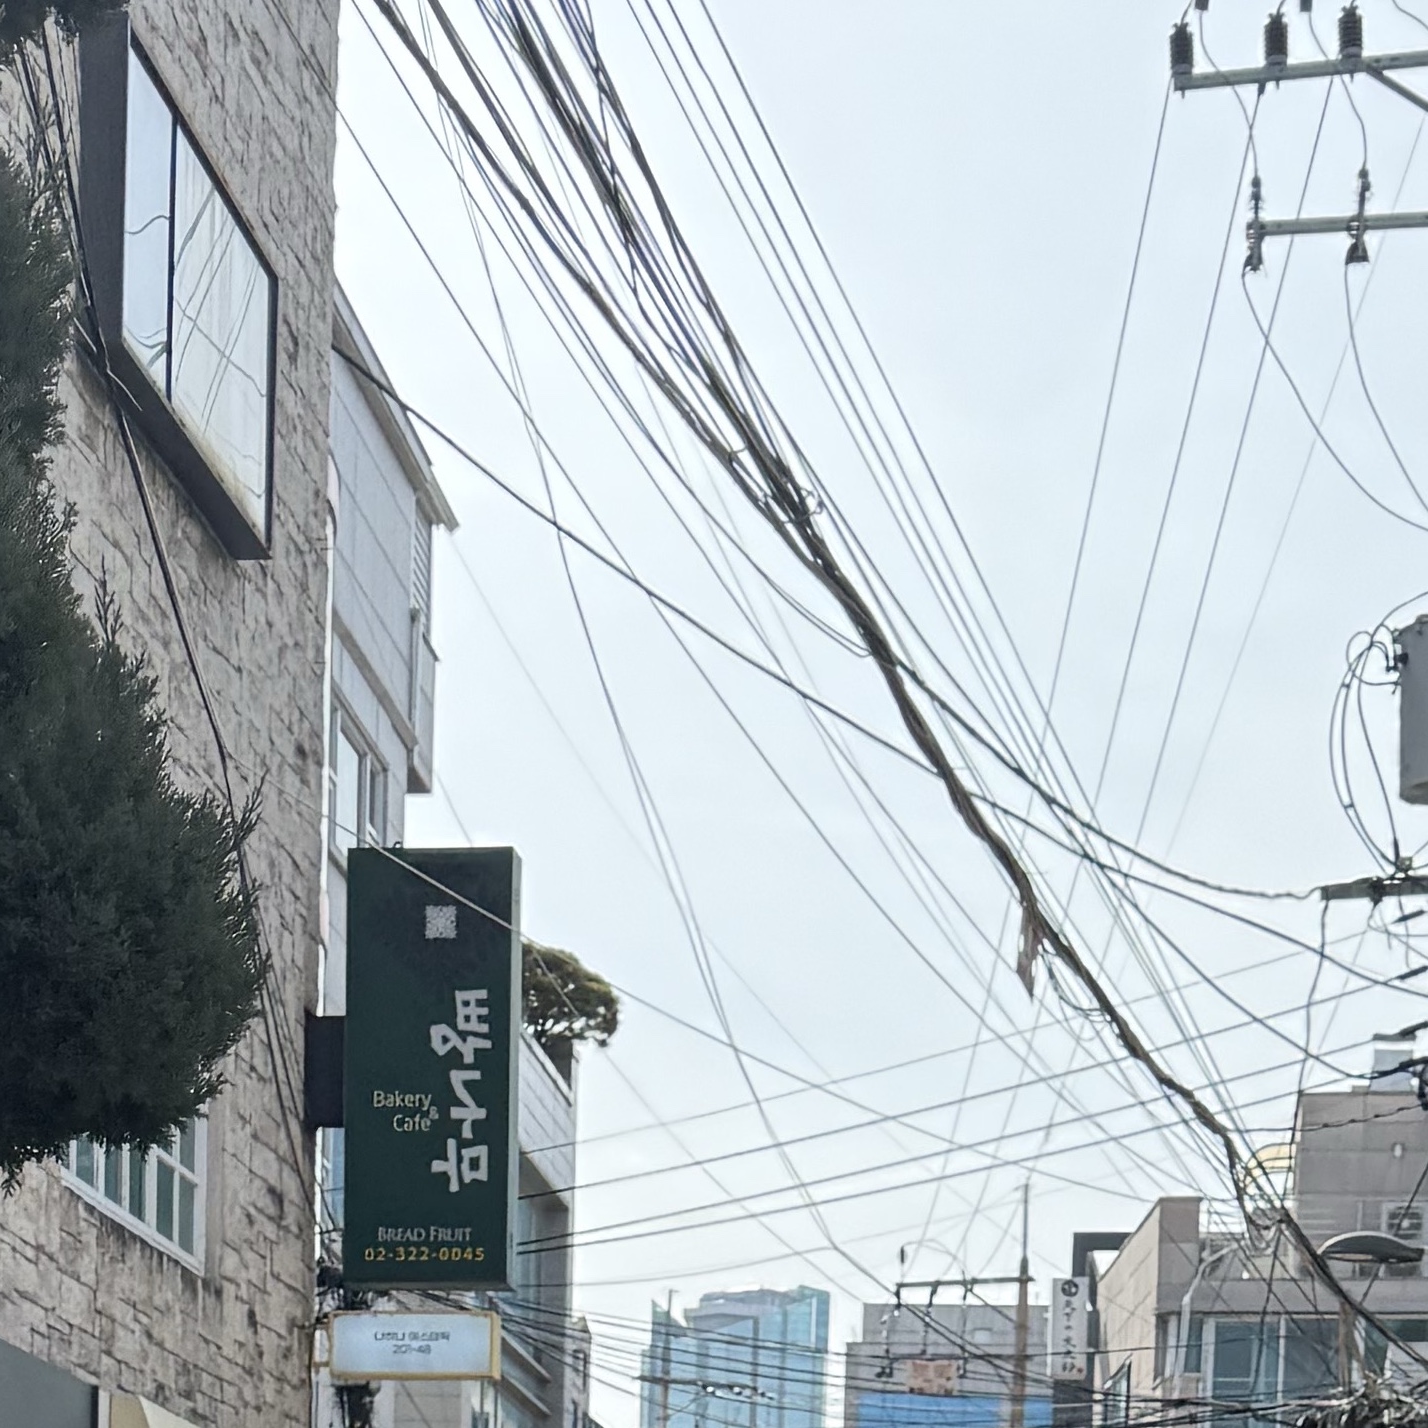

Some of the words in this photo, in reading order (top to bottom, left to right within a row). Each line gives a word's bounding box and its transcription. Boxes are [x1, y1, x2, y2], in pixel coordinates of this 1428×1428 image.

[430, 988, 493, 1193] 빵나무
[372, 1090, 433, 1115] Bakery
[428, 1106, 440, 1120] &
[392, 1114, 432, 1132] Cafe
[377, 1226, 427, 1243] BREAD
[364, 1246, 486, 1262] 02-322-0045
